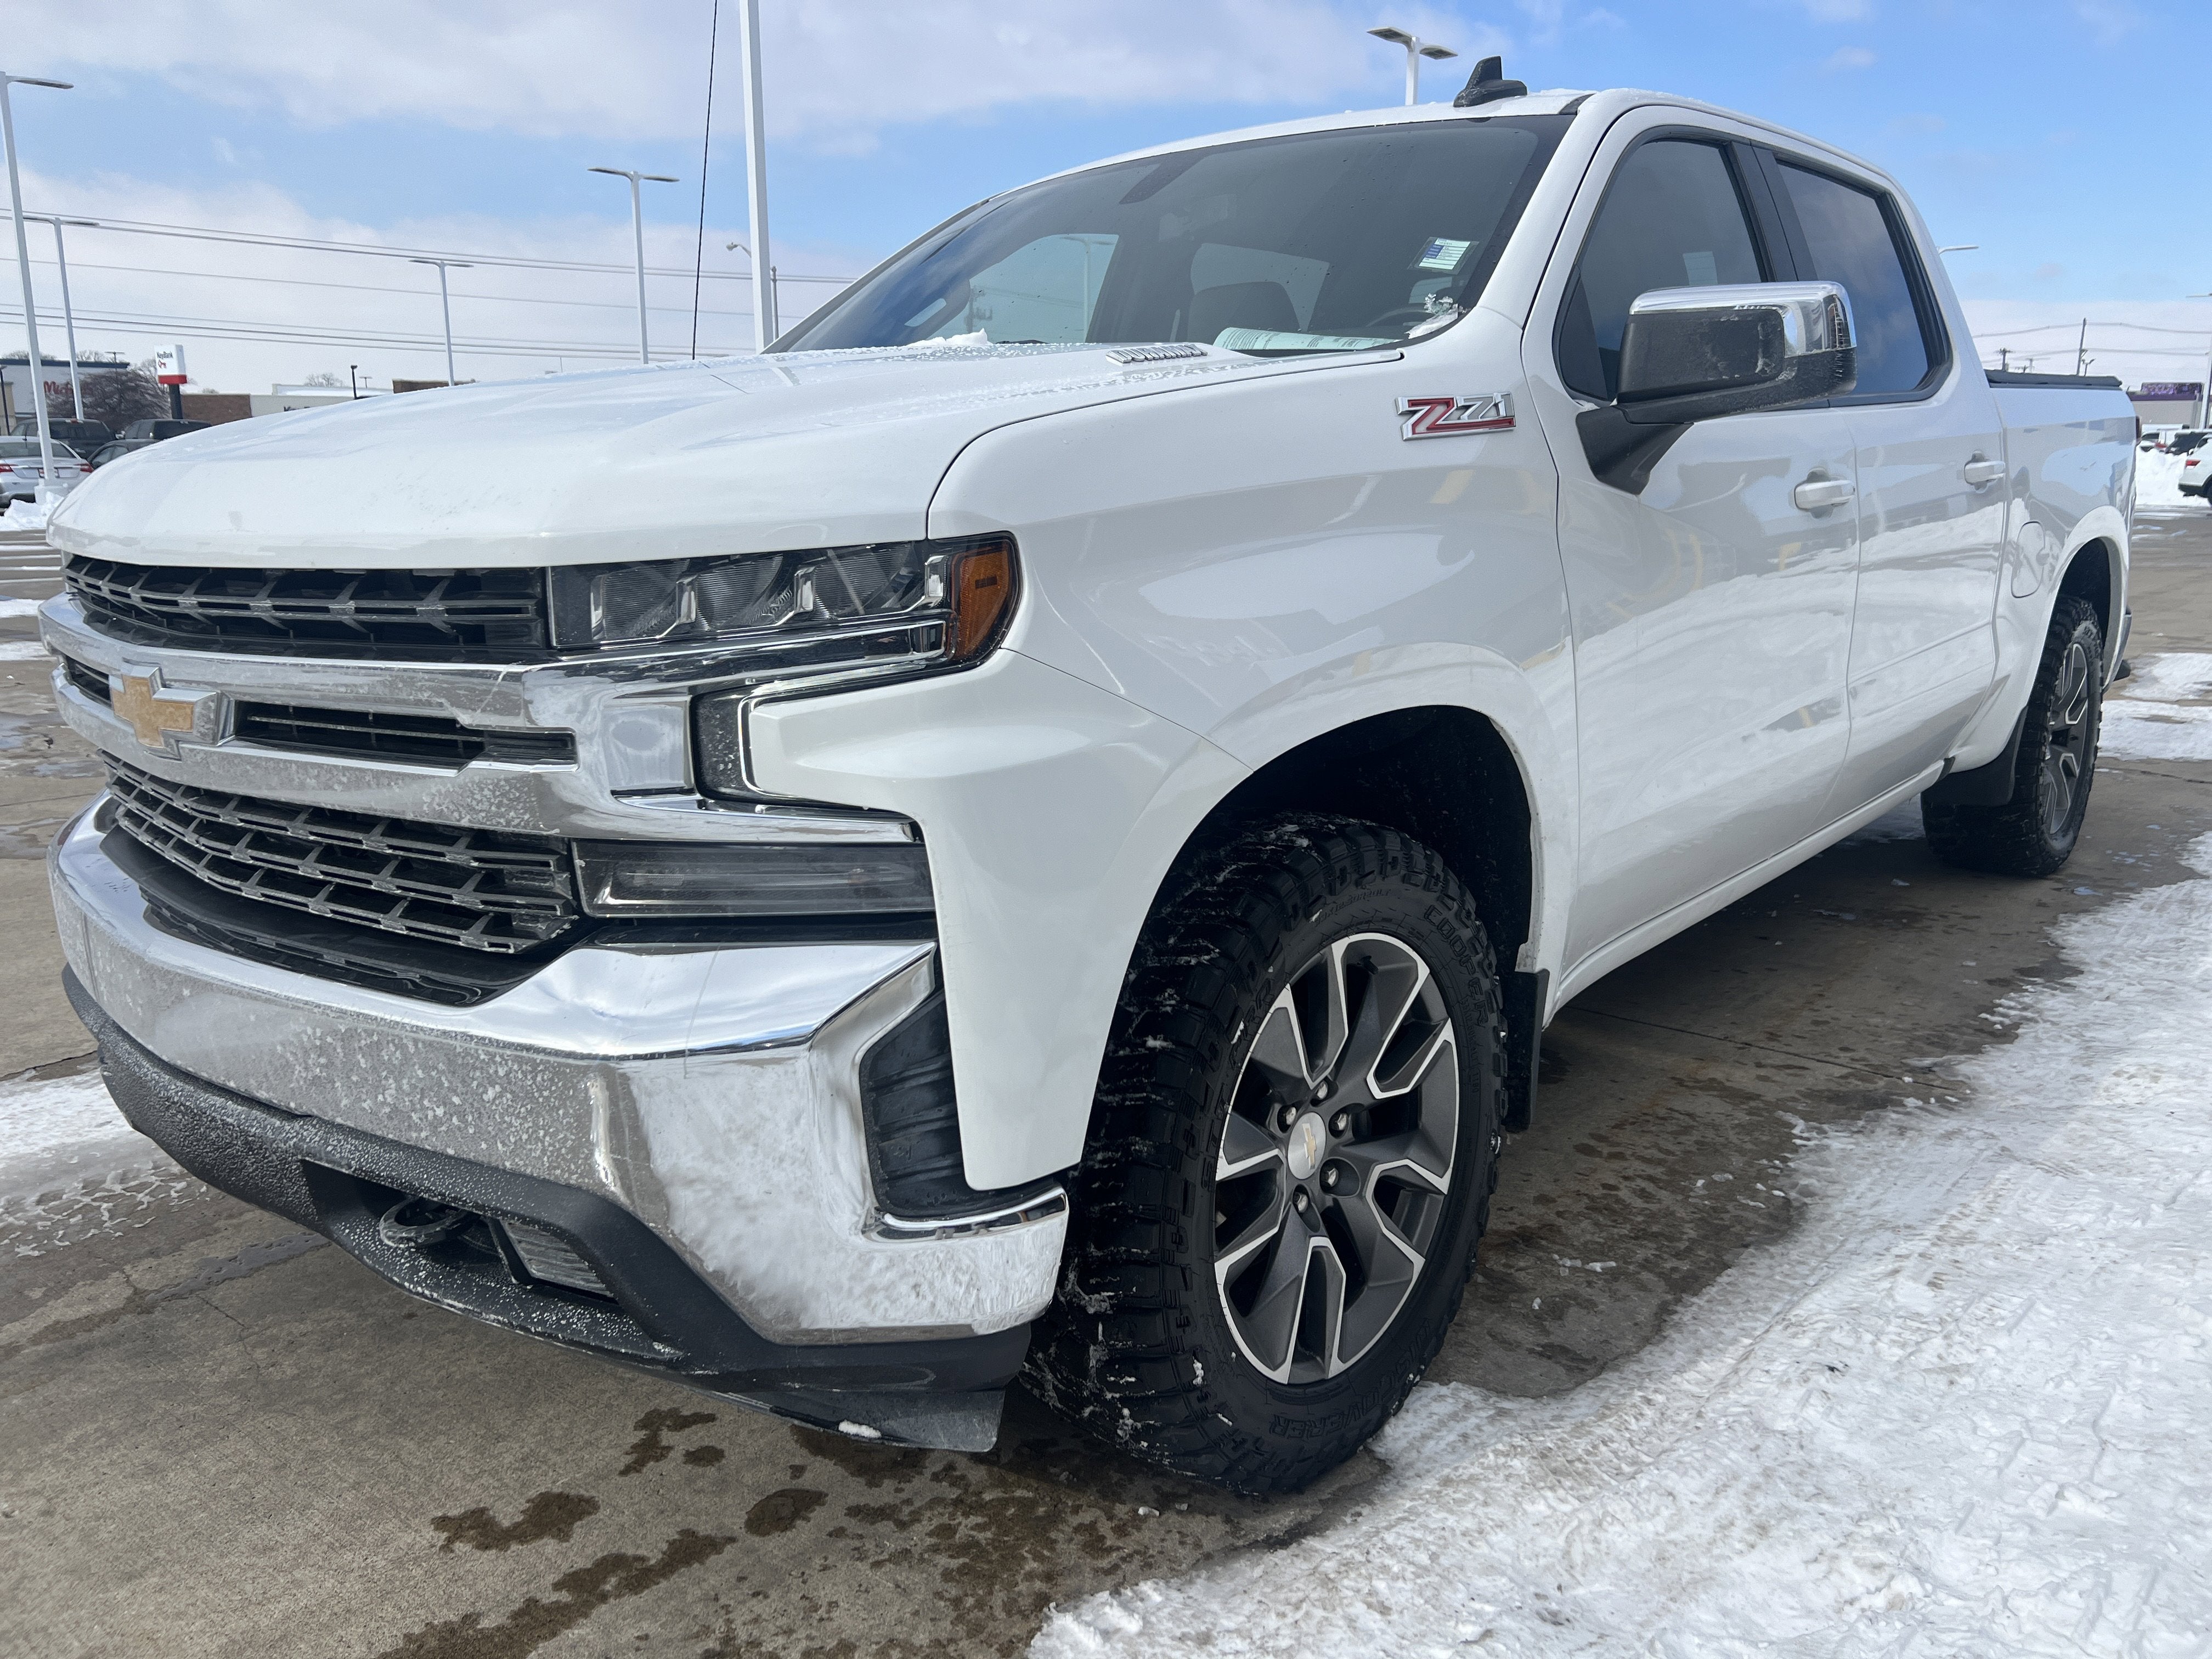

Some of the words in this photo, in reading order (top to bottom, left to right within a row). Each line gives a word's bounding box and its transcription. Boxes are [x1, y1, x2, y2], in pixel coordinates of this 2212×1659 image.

[156, 351, 173, 359] KeyBank
[1105, 344, 1208, 364] DURAMAX
[1394, 391, 1516, 441] Z71
[1424, 904, 1488, 1026] COOPER
